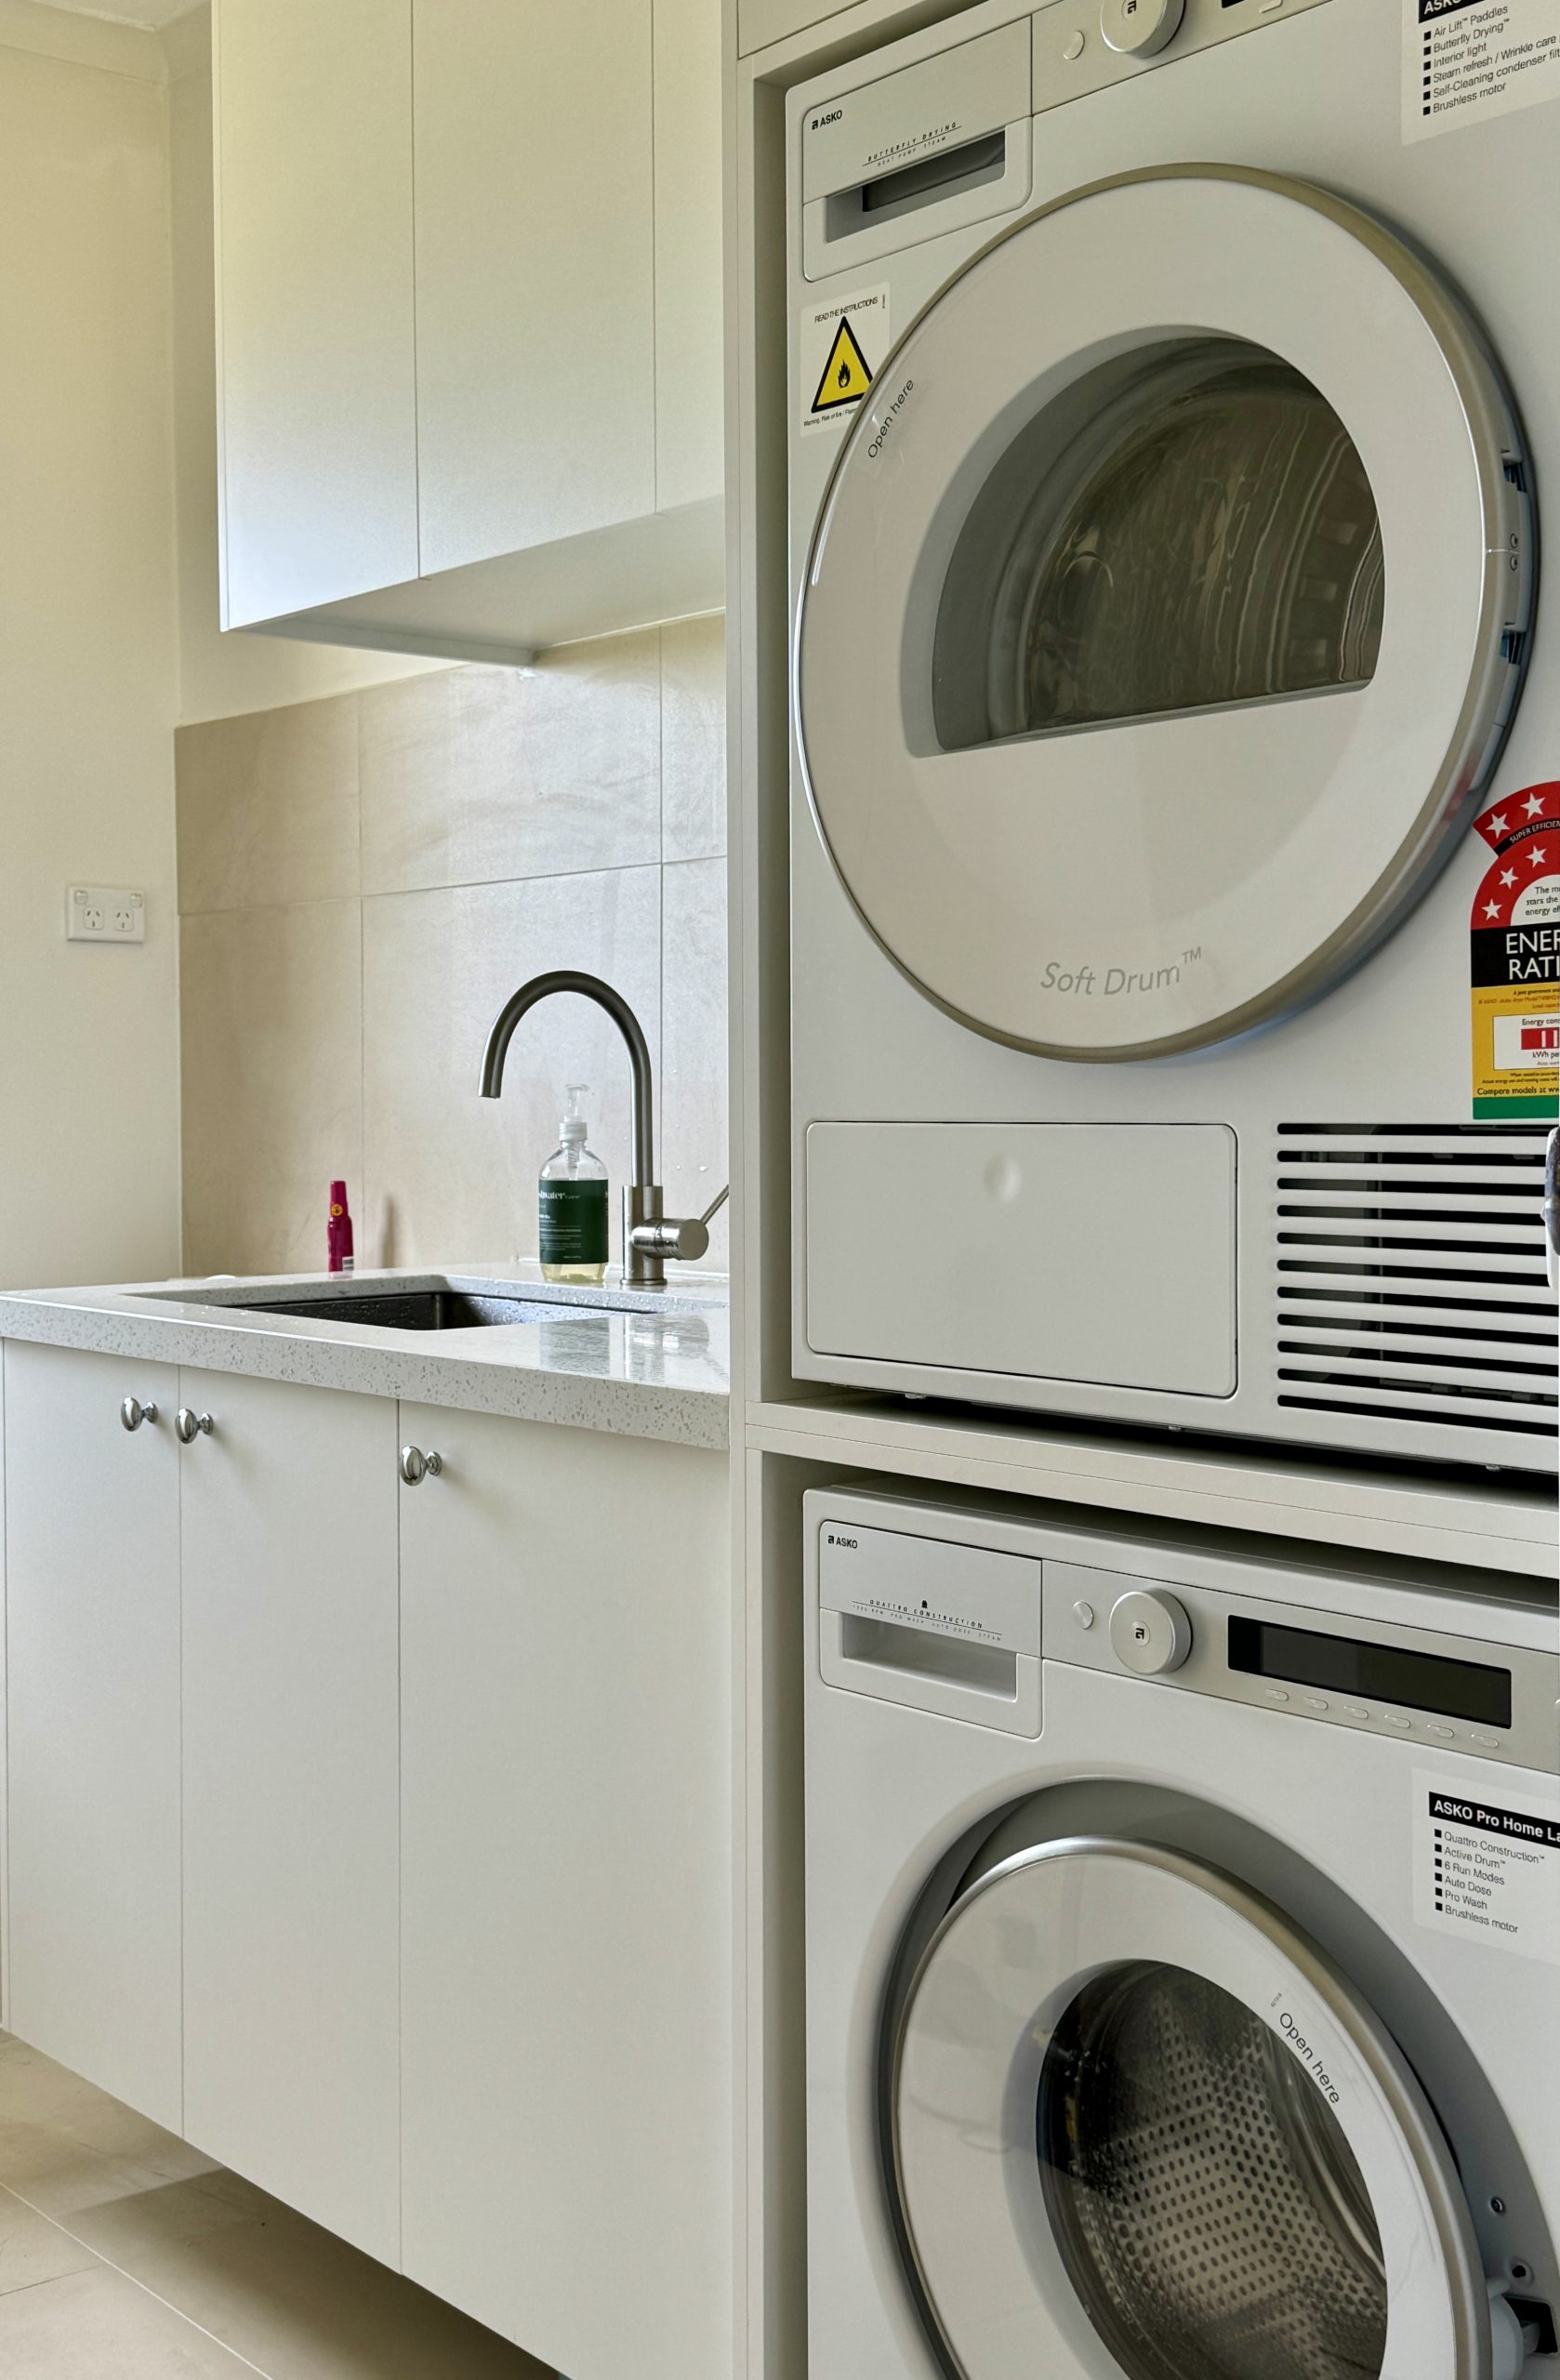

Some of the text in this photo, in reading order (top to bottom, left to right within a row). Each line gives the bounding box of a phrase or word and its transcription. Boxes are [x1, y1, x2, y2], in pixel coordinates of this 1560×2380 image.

[1424, 0, 1462, 15] ASK
[1434, 25, 1447, 38] Air
[1470, 6, 1508, 25] Paddles
[1434, 33, 1471, 53] Butterfly
[1433, 68, 1461, 83] Steam
[1463, 56, 1493, 73] refresh
[1501, 43, 1533, 60] Wrinkle
[1536, 35, 1556, 48] care
[1434, 43, 1487, 68] Interior light
[1433, 72, 1494, 98] Self-Cleaning
[1497, 54, 1547, 76] condenser
[1433, 83, 1507, 112] Brushless motor
[820, 110, 843, 127] ASKO
[867, 122, 957, 162] BUTTERFLY DRYING
[814, 312, 828, 324] READ
[829, 309, 839, 319] THE
[839, 297, 879, 315] INSTRUCTIONS
[867, 379, 914, 458] Open here
[1509, 827, 1531, 843] SUPER
[1534, 886, 1550, 894] The
[1546, 894, 1558, 904] the
[1039, 961, 1096, 996] Soft
[1522, 1018, 1544, 1026] Energy
[1532, 1051, 1549, 1059] kWh
[1477, 1087, 1511, 1096] Compare
[836, 1537, 858, 1549] ASKO
[870, 1599, 907, 1612] QUATTRO
[914, 1609, 983, 1628] CONSTRUCTION
[1434, 1800, 1473, 1819] ASKO
[1476, 1810, 1500, 1827] Pro
[1503, 1817, 1543, 1837] Home
[1444, 1831, 1478, 1847] Quattro
[1444, 1846, 1472, 1861] Active
[1453, 1864, 1471, 1875] Run
[1474, 1868, 1505, 1885] Modes
[1445, 1876, 1492, 1897] Auto Dose
[1445, 1891, 1487, 1910] Pro Wash
[1445, 1905, 1518, 1934] Brushless motor
[1280, 2013, 1340, 2104] Open here
